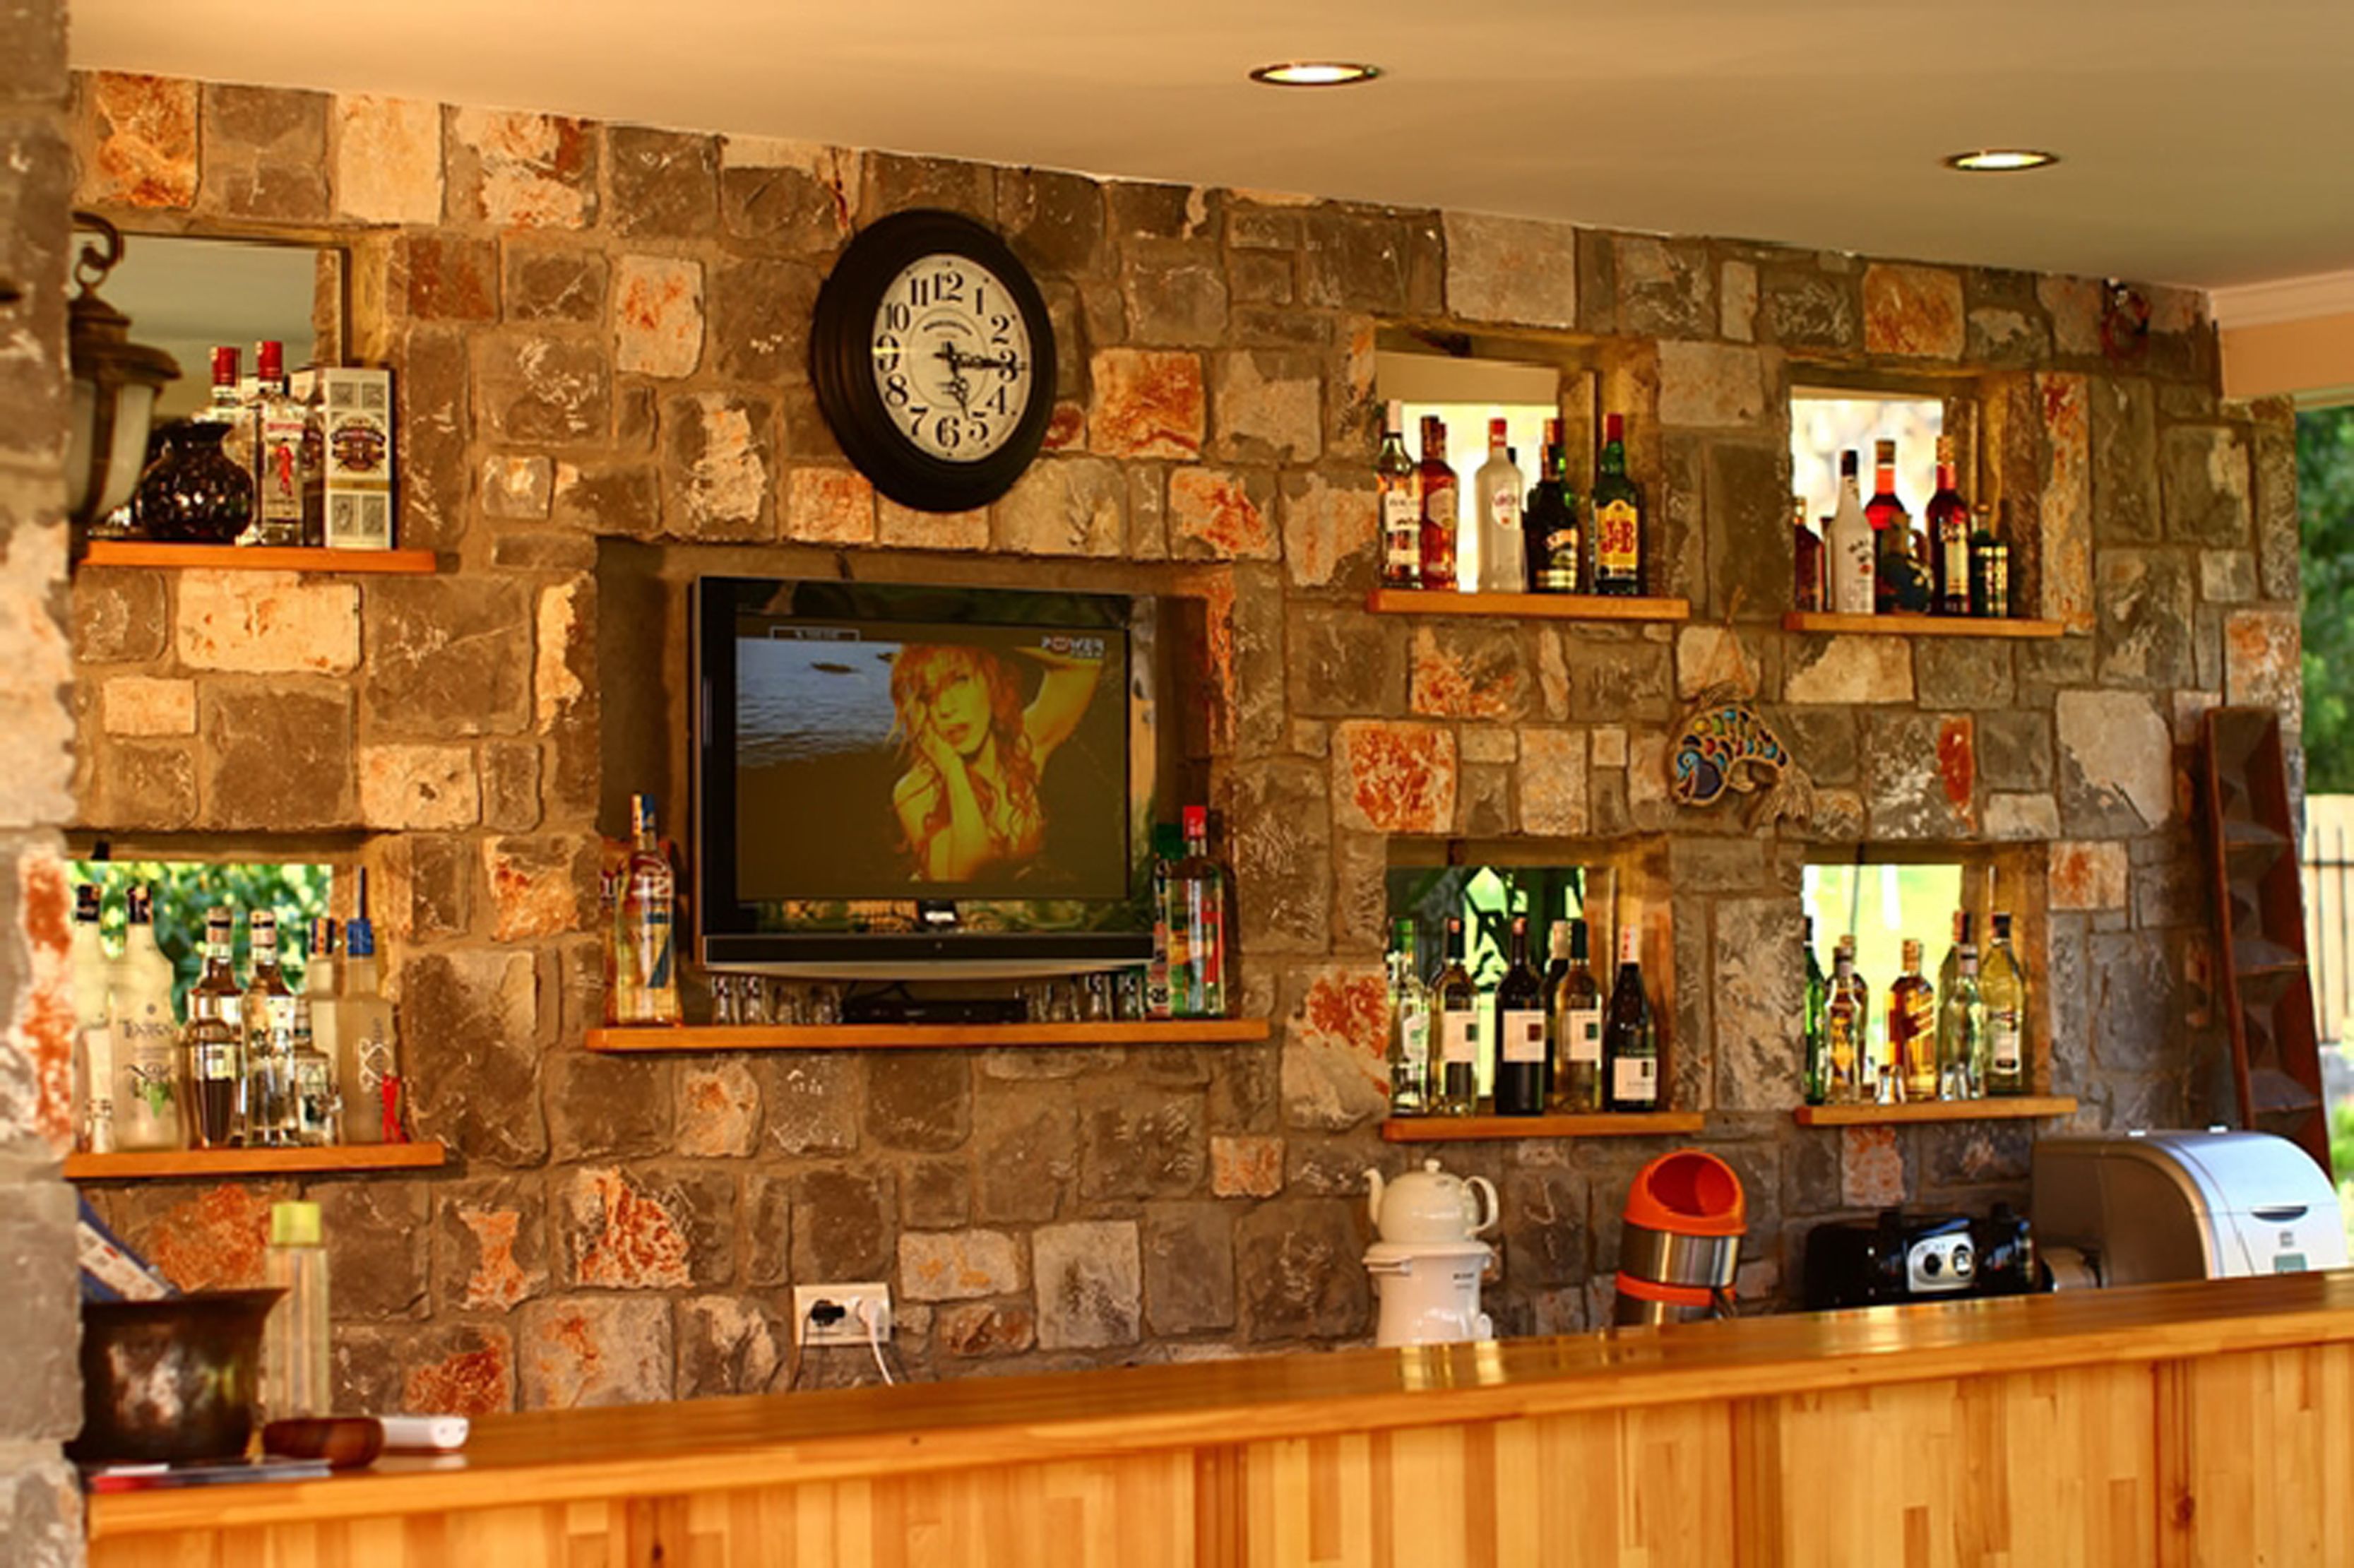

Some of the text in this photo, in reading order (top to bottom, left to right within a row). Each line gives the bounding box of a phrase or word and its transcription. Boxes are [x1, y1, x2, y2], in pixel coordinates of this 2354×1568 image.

[911, 278, 927, 307] 11
[934, 271, 963, 303] 12
[976, 287, 982, 315] 1
[886, 302, 910, 332] 10
[991, 314, 1009, 345] 2
[876, 334, 899, 373] 9
[999, 350, 1018, 383] 3
[885, 374, 908, 407] 8
[986, 385, 1005, 415] 4
[909, 407, 928, 436] 7
[935, 416, 960, 449] 6
[968, 411, 988, 442] 5
[1041, 636, 1104, 652] POWER
